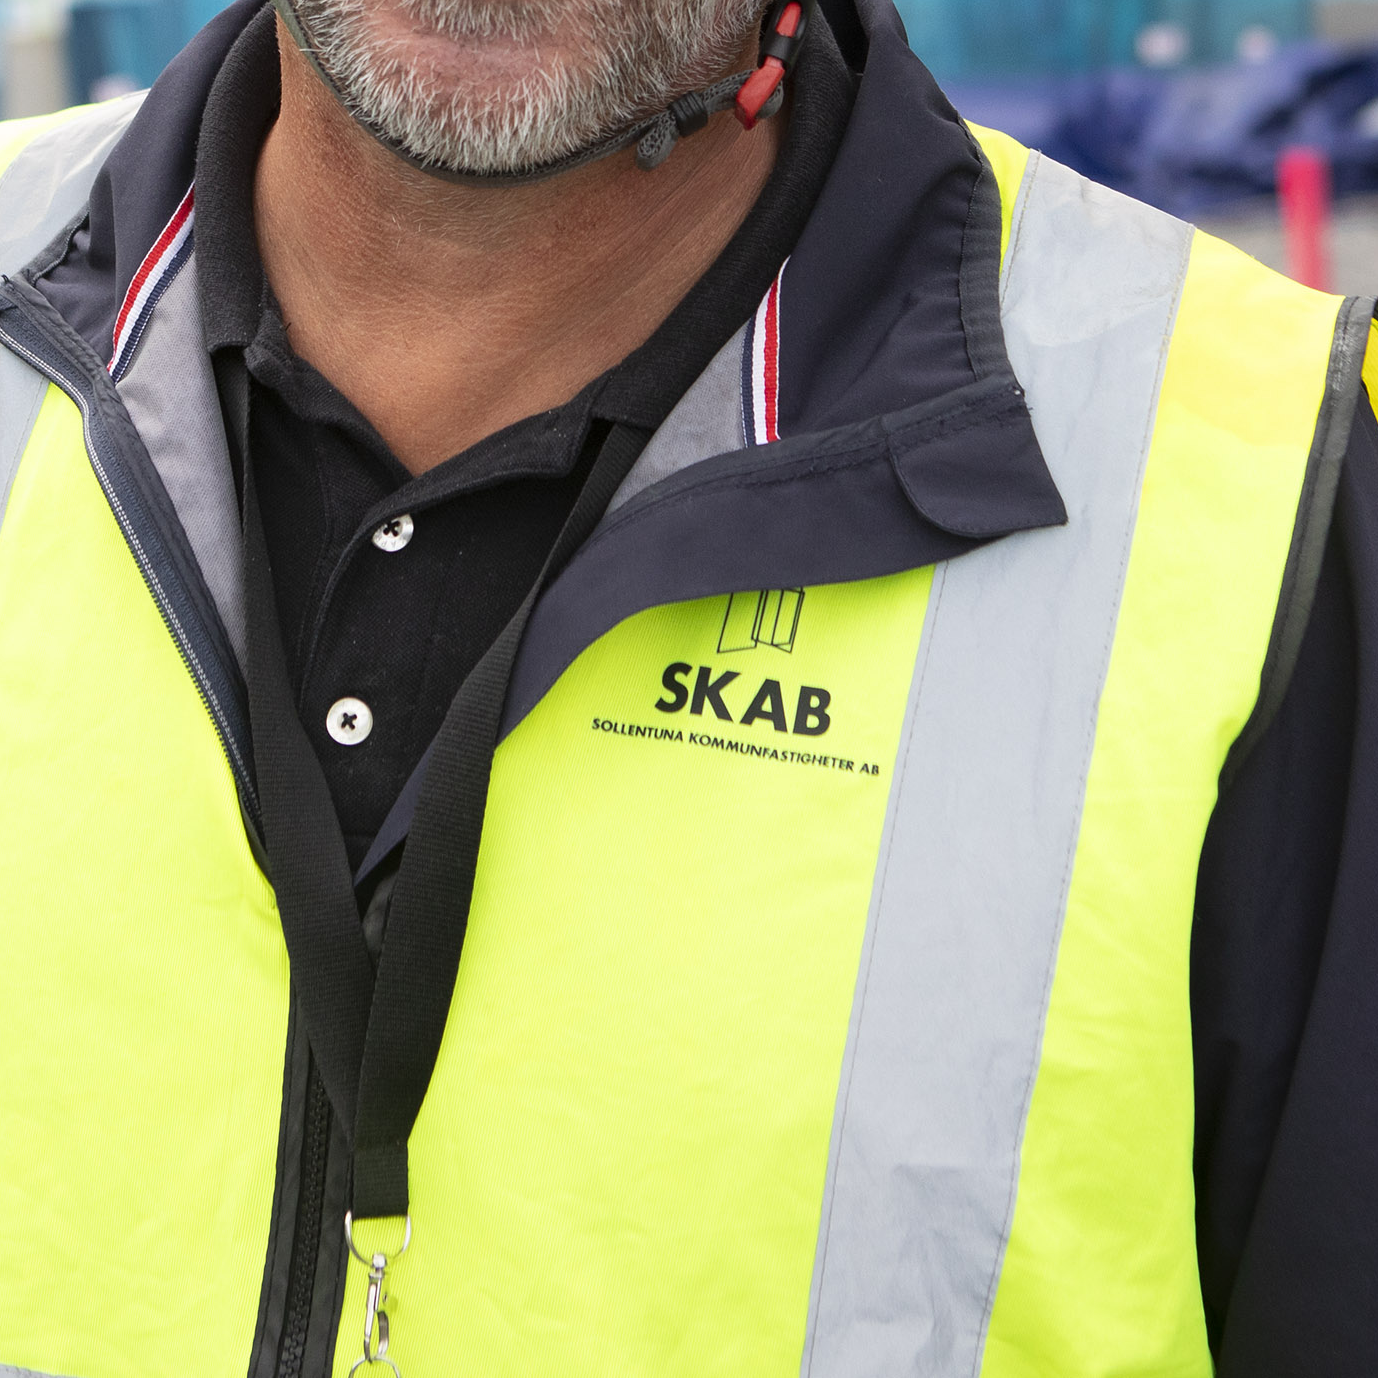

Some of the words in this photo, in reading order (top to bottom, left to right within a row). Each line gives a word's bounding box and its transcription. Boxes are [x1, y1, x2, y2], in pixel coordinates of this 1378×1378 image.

[654, 661, 831, 737] SKAB
[592, 718, 684, 743] SOLLENTUNA
[688, 732, 855, 772] KOMMUNFASTIGHETER
[859, 762, 880, 776] AB
